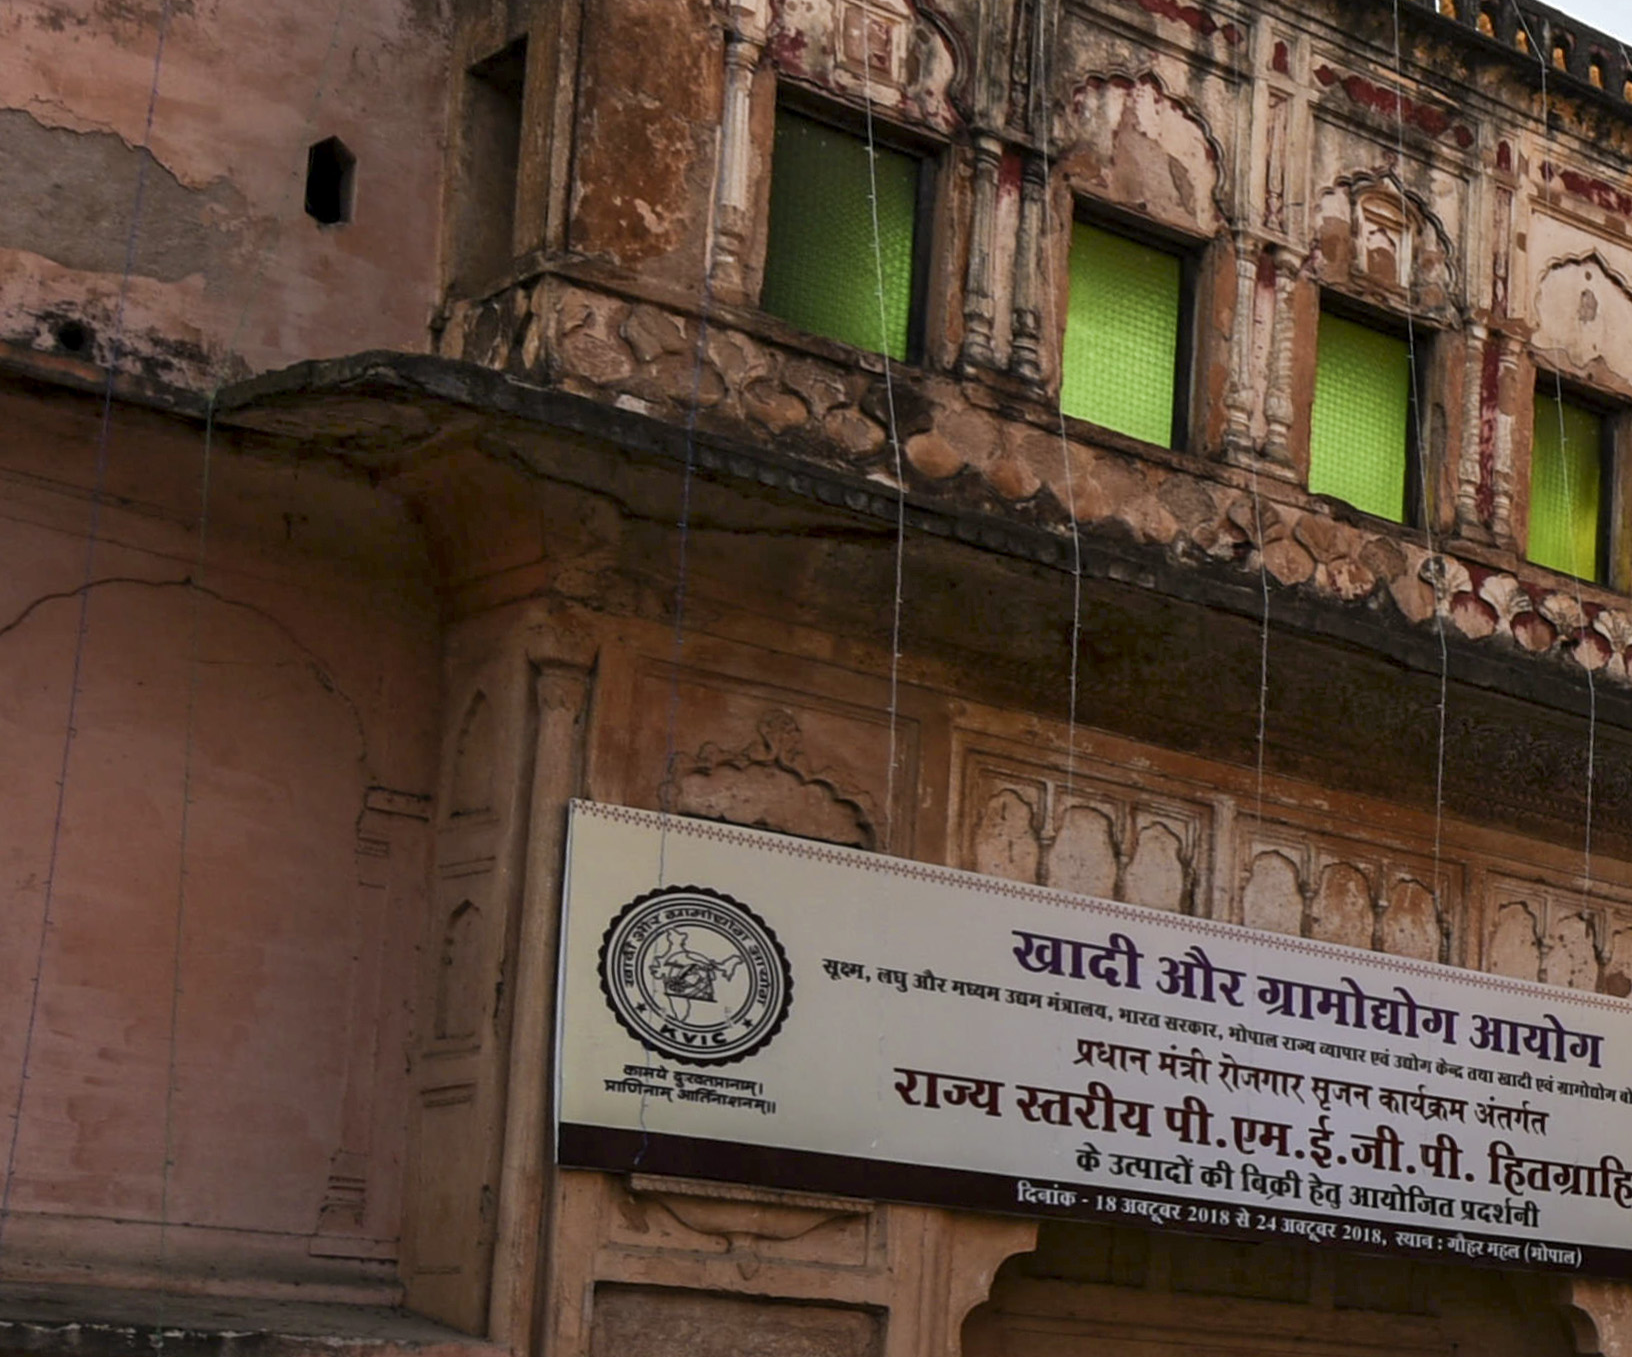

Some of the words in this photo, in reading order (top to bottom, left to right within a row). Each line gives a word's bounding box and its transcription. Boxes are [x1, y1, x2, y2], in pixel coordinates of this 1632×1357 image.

[659, 1023, 728, 1046] KVIC
[822, 958, 871, 983] सूक्ष्म,
[877, 967, 909, 993] लघु
[912, 968, 948, 993] और
[951, 980, 1001, 1002] मध्यम
[1005, 988, 1043, 1009] उद्यम
[1047, 991, 1113, 1023] मंत्रालय,
[1119, 1006, 1160, 1029] भारत
[1164, 1014, 1223, 1041] सरकार,
[1228, 1023, 1279, 1049] भोपाल
[1282, 1036, 1316, 1055] राज्य
[1319, 1042, 1366, 1063] व्यापार
[1370, 1048, 1391, 1067] एवं
[1394, 1053, 1432, 1074] उद्योग
[1434, 1058, 1464, 1078] केन्द्र
[1467, 1067, 1494, 1083] तथा
[1497, 1070, 1533, 1089] खादी
[1535, 1075, 1555, 1093] एवं
[1012, 930, 1144, 991] खादी
[1156, 946, 1247, 1007] और
[1256, 975, 1460, 1045] ग्रामोद्योग
[1469, 1013, 1605, 1069] आयोग
[893, 1067, 1005, 1117] राज्य
[1016, 1081, 1155, 1138] स्तरीय
[1164, 1095, 1475, 1183] पी.एम.ई.जी.पी.
[1073, 1038, 1151, 1076] प्रधान
[1158, 1044, 1213, 1085] मंत्री
[1218, 1052, 1305, 1104] रोजगार
[1311, 1075, 1373, 1111] सृजन
[1378, 1084, 1469, 1124] कार्यक्रम
[1474, 1096, 1550, 1137] अंतर्गत
[1017, 1180, 1077, 1207] दिनांक
[1095, 1194, 1116, 1212] 18
[1187, 1205, 1230, 1225] 2018
[1235, 1207, 1251, 1228] से
[1256, 1214, 1277, 1232] 24
[1341, 1224, 1388, 1247] 2018,
[1395, 1231, 1433, 1251] स्थान
[1447, 1232, 1485, 1258] गौहर
[1487, 1241, 1520, 1261] महल
[1523, 1242, 1583, 1268] (भोपाल)
[1075, 1142, 1101, 1173] के
[1108, 1152, 1194, 1185] उत्पादों
[1199, 1160, 1235, 1190] की
[1241, 1163, 1303, 1200] बिक्री
[1308, 1173, 1343, 1209] हेतु
[1349, 1183, 1455, 1218] आयोजित
[1460, 1198, 1541, 1228] प्रदर्शनी
